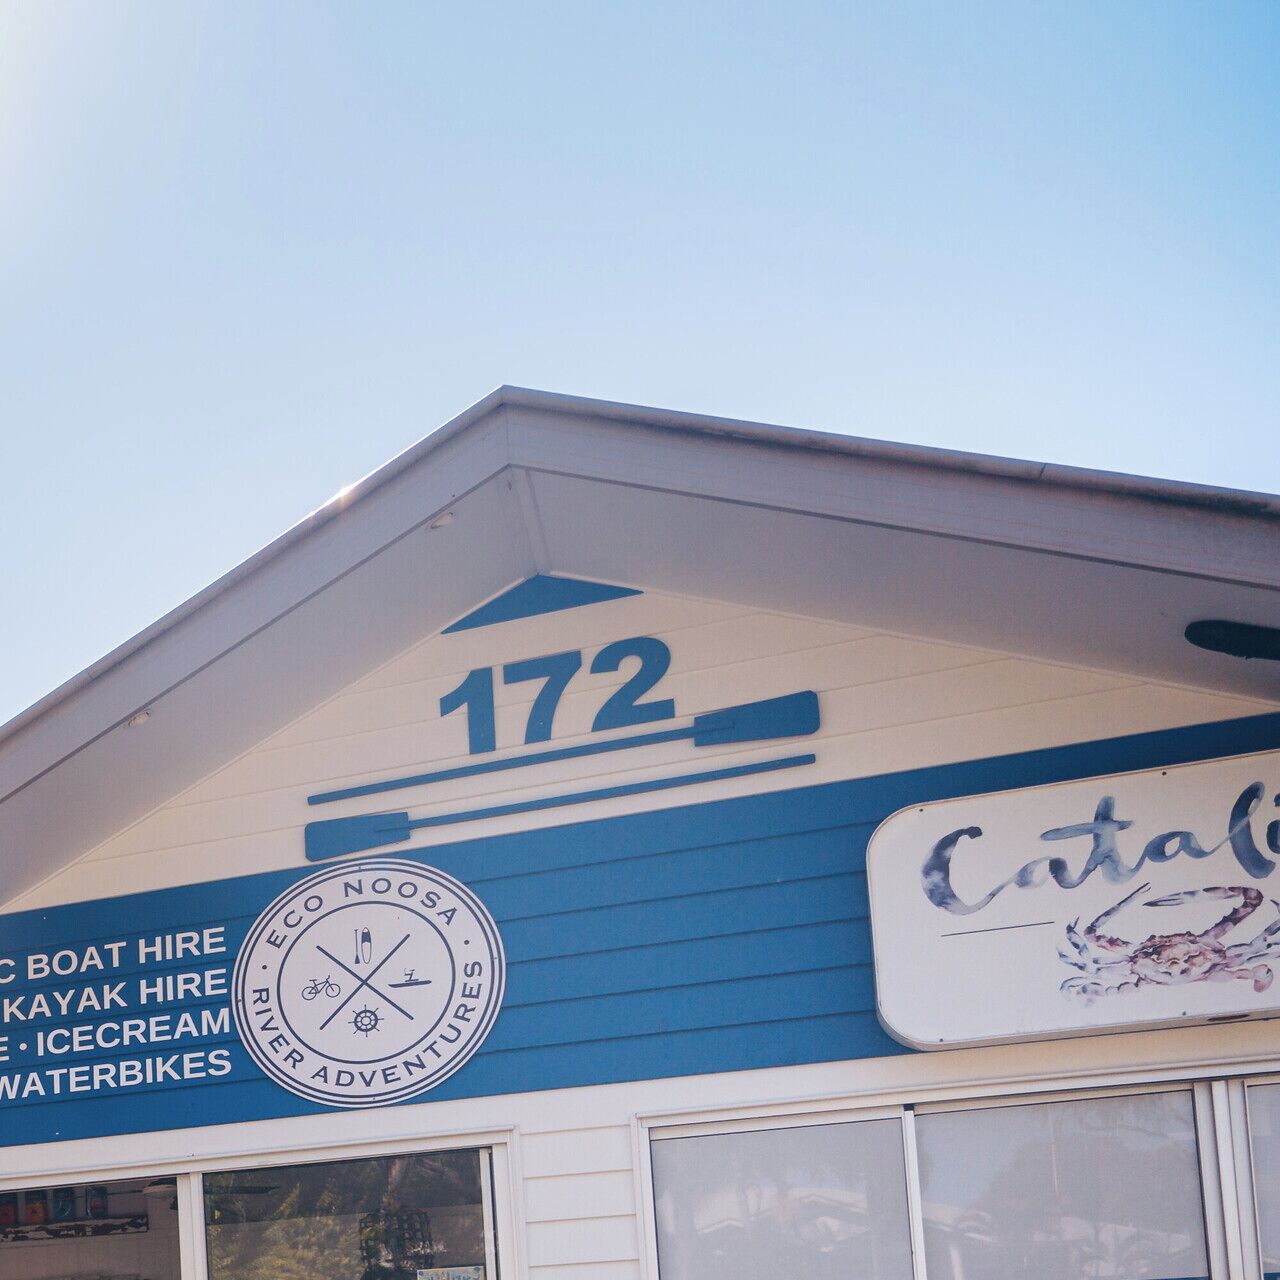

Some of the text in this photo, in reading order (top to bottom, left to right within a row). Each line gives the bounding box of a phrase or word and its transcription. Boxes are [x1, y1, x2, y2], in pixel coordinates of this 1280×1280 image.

[440, 636, 675, 755] 172
[266, 878, 458, 949] ECO NOOSA
[26, 941, 127, 981] BOAT
[138, 926, 227, 965] HIRE
[3, 982, 128, 1023] KAYAK
[140, 968, 228, 1005] HIRE
[252, 960, 483, 1088] RIVER ADVENTURES
[37, 1007, 230, 1057] ICECREAM
